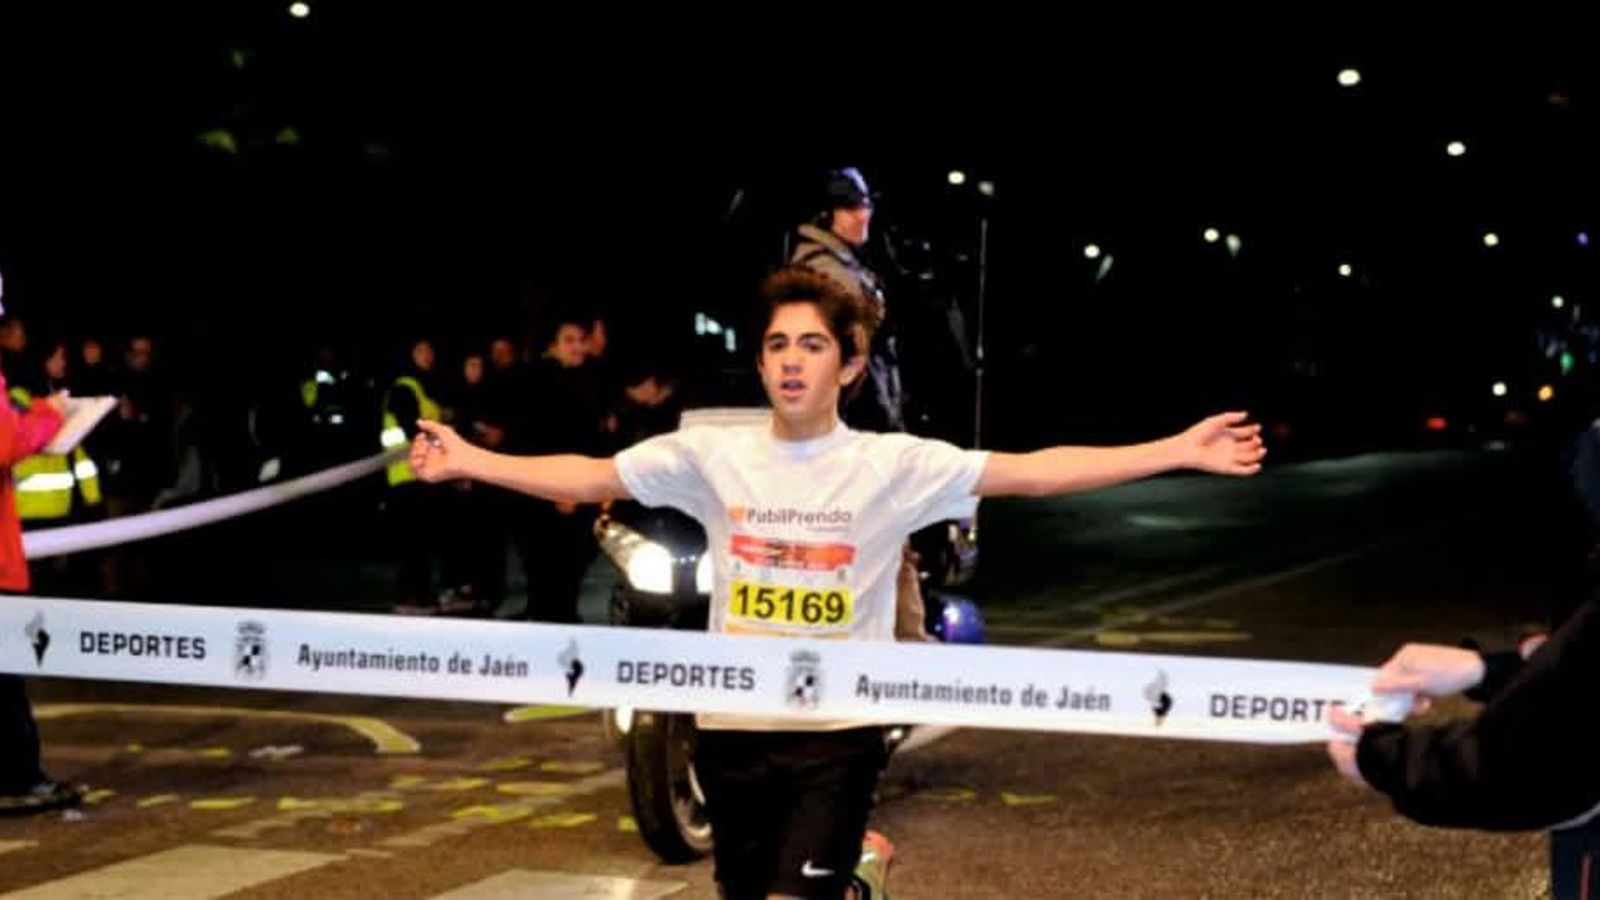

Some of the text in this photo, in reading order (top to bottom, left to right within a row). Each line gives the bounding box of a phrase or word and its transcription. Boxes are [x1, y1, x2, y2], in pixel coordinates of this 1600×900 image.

[736, 584, 847, 625] 15169
[79, 630, 207, 660] DEPORTES
[297, 643, 529, 677] Ayuntamiento de Jaén
[617, 660, 755, 691] DEPORTES
[855, 674, 1111, 712] Ayuntamiento de Jaén
